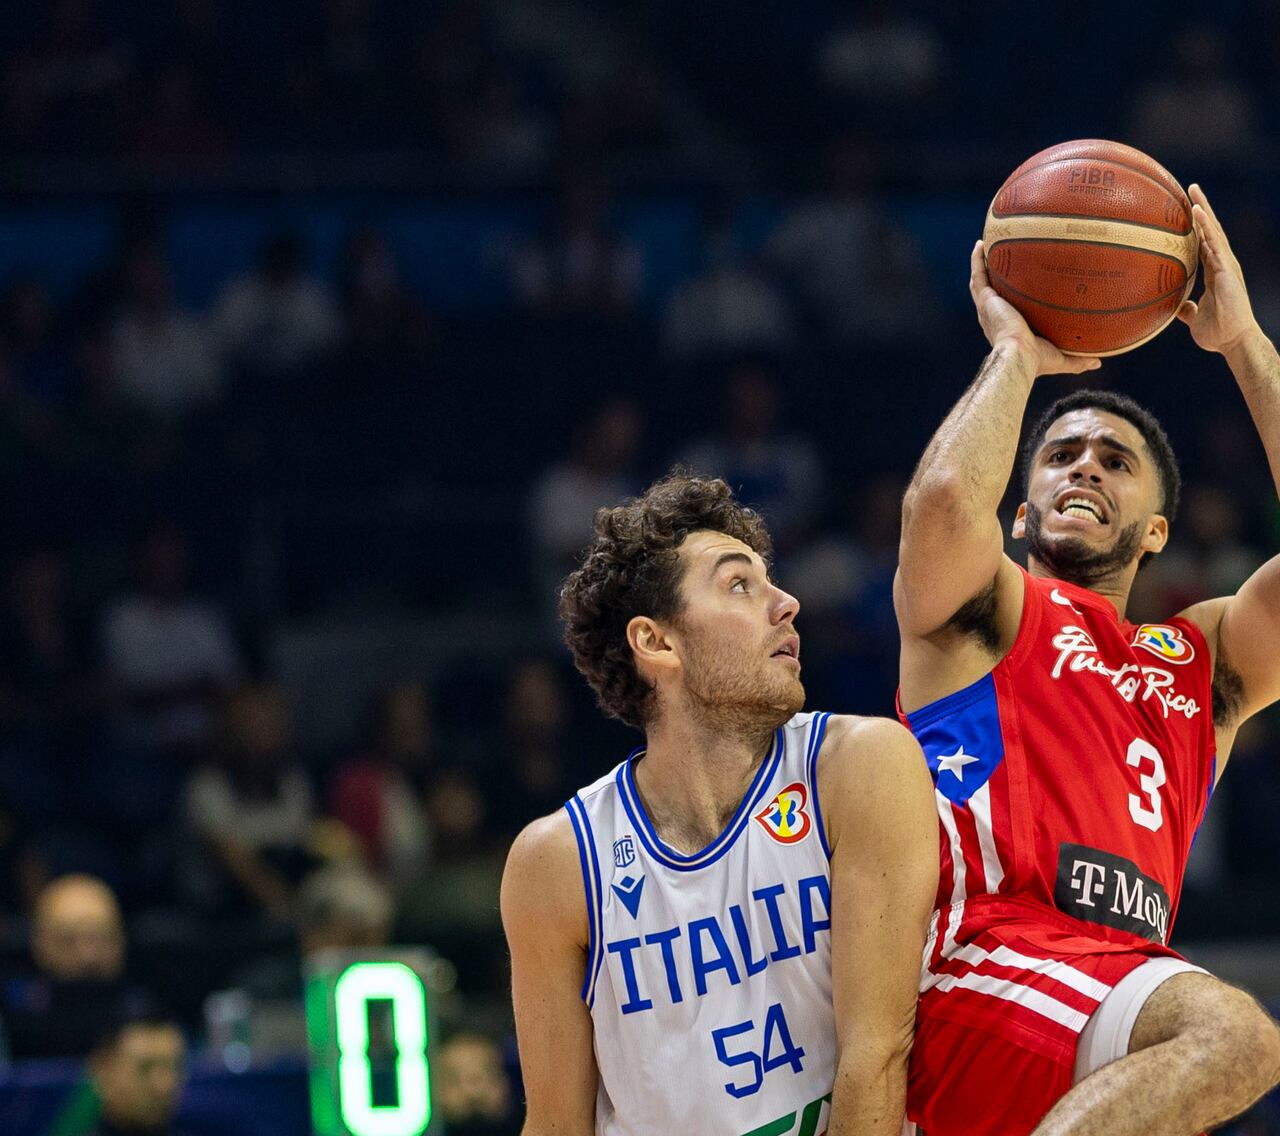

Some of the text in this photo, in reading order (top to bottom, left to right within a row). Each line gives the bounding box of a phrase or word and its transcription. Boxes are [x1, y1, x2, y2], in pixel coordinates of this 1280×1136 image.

[1052, 625, 1200, 719] Pueto Rico
[1126, 738, 1166, 832] 3
[608, 875, 831, 1014] ITALIA
[1110, 870, 1167, 947] Mob
[712, 1003, 806, 1099] 54
